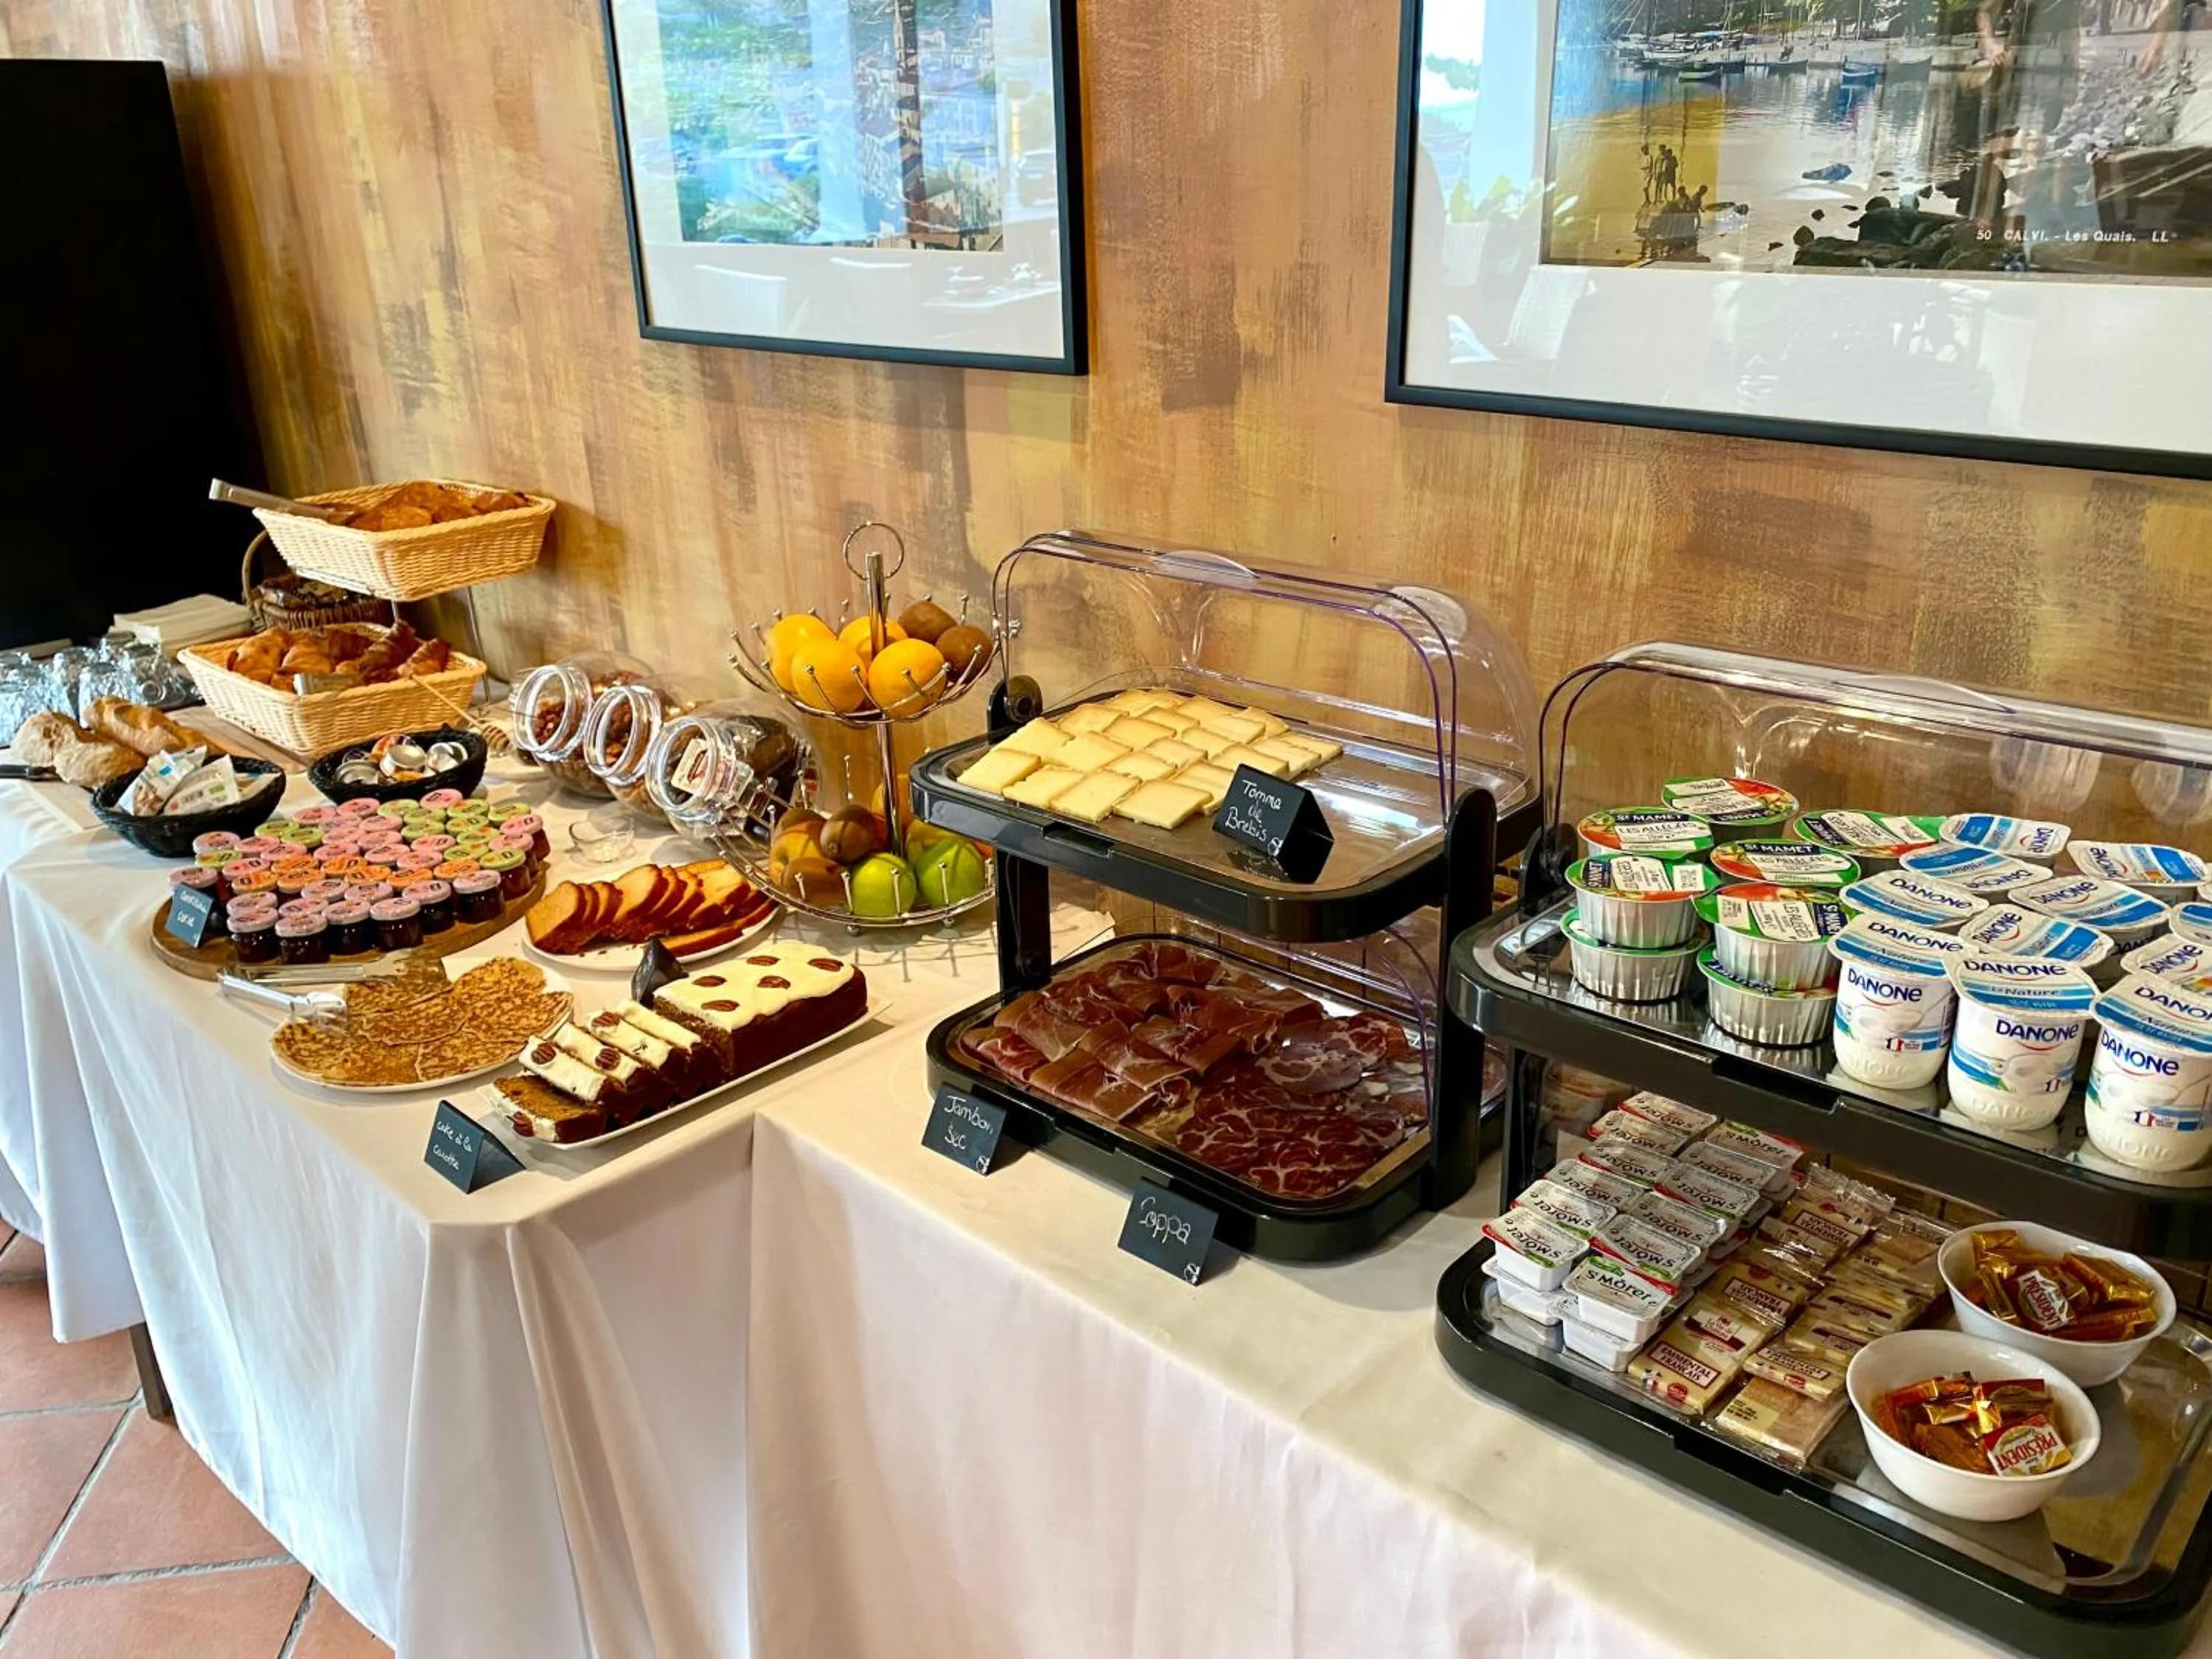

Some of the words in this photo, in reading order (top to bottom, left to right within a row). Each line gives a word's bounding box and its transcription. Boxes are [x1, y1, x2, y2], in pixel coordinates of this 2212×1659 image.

[1976, 230, 1992, 240] 50
[2004, 230, 2050, 242] CALVI.
[2065, 230, 2088, 242] Les
[2093, 230, 2137, 243] Quais.
[1225, 806, 1267, 842] Brebis
[1138, 1195, 1192, 1245] Coppa
